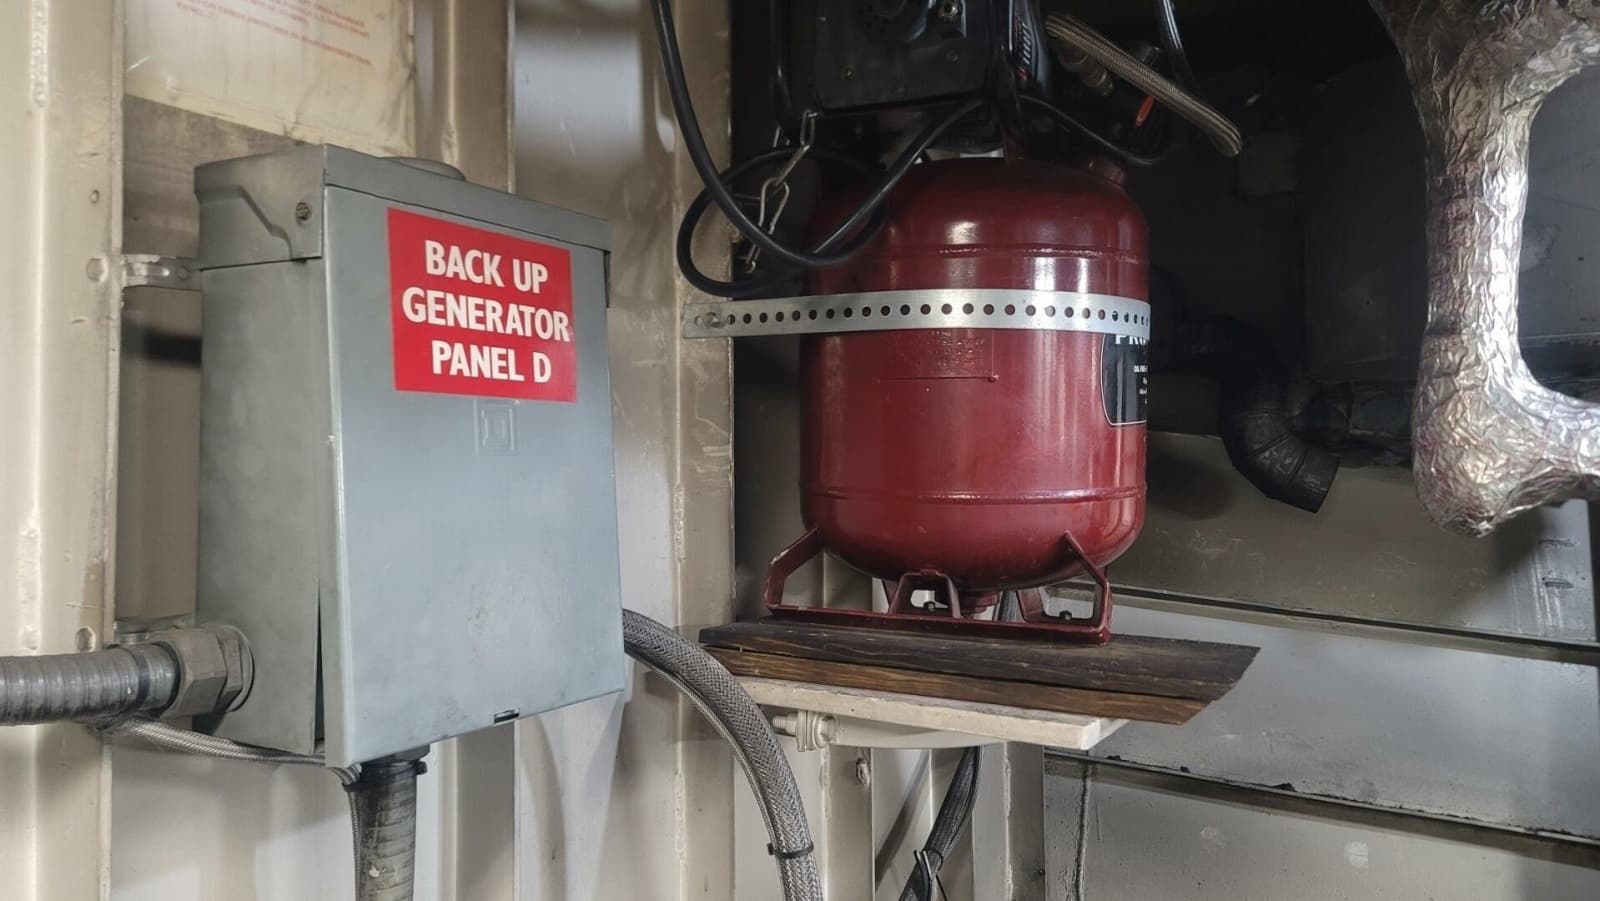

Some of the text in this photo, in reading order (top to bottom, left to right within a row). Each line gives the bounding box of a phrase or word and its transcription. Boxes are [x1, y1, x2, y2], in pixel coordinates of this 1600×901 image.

[424, 240, 549, 294] BACK UP
[402, 286, 570, 342] GENERATOR
[431, 340, 552, 383] PANEL D
